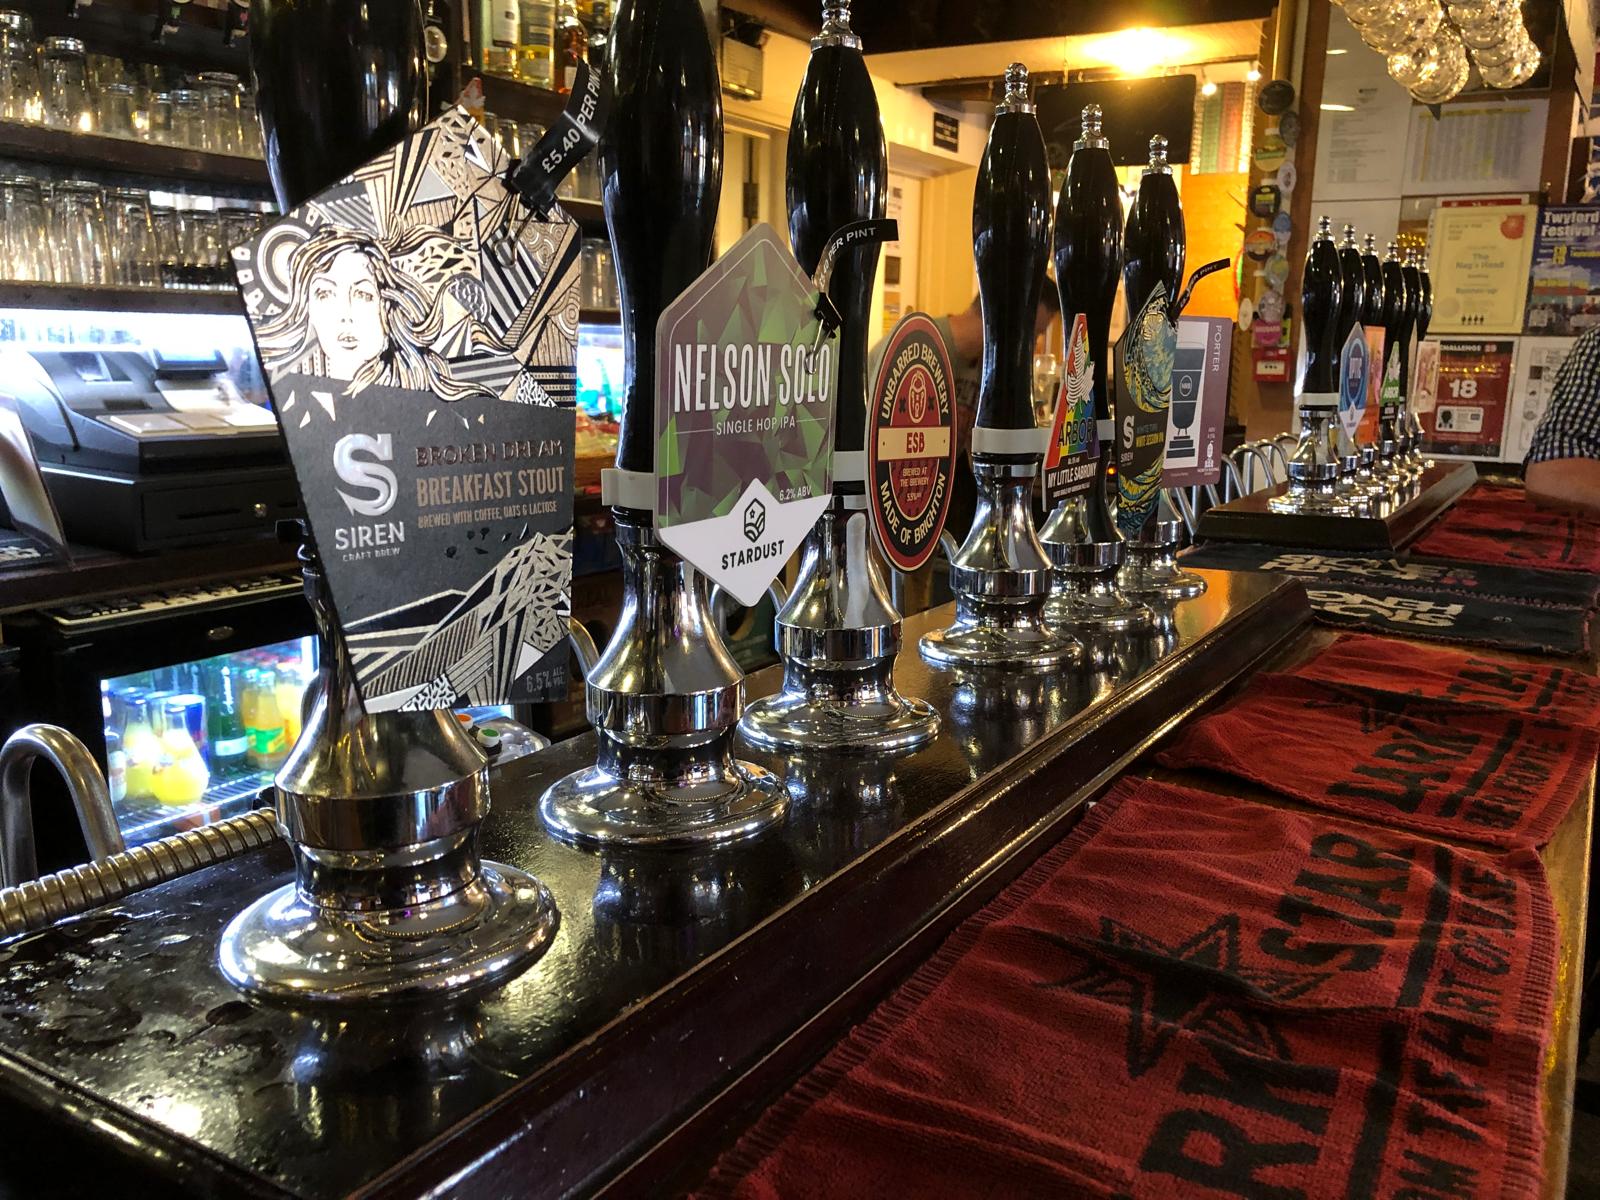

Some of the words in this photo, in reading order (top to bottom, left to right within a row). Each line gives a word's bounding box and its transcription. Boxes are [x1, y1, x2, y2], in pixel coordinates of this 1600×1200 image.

[541, 128, 581, 174] £5.40
[576, 94, 597, 128] PER
[1541, 224, 1596, 237] Festival
[1544, 211, 1599, 225] Twyford
[828, 237, 844, 260] PER
[846, 227, 877, 243] PINT
[1212, 324, 1223, 372] PORTER
[674, 343, 772, 413] NELSON
[779, 343, 830, 406] SOLO
[881, 342, 920, 419] UNBARRED
[921, 343, 949, 415] BREWERY
[1449, 379, 1478, 398] 18
[716, 420, 753, 436] SINGLE
[756, 417, 776, 433] HOP
[780, 415, 796, 430] IPA
[1058, 416, 1095, 447] ARBOR
[415, 443, 497, 468] BROKEN
[502, 439, 564, 461] DREAM
[906, 432, 925, 454] ESB
[900, 479, 909, 487] THE
[921, 466, 928, 476] AT
[1048, 472, 1057, 488] MY
[1057, 468, 1073, 486] LITTLE
[416, 471, 512, 507] BREAKFAST
[517, 466, 565, 497] STOUT
[797, 486, 812, 498] ABV
[417, 514, 450, 529] BREWED
[452, 510, 472, 525] WITH
[474, 506, 502, 523] COFFEE,
[503, 504, 521, 520] OATS
[522, 505, 528, 515] &
[529, 501, 558, 515] LACTOSE
[880, 480, 900, 535] MADE
[900, 527, 912, 545] OF
[914, 472, 946, 545] BRIGHTON
[335, 521, 405, 551] SIREN
[342, 549, 371, 562] CRAFT
[375, 546, 401, 559] BREW
[721, 540, 785, 571] STARDUST
[526, 670, 552, 693] 6.5%
[1259, 832, 1415, 972] STAR
